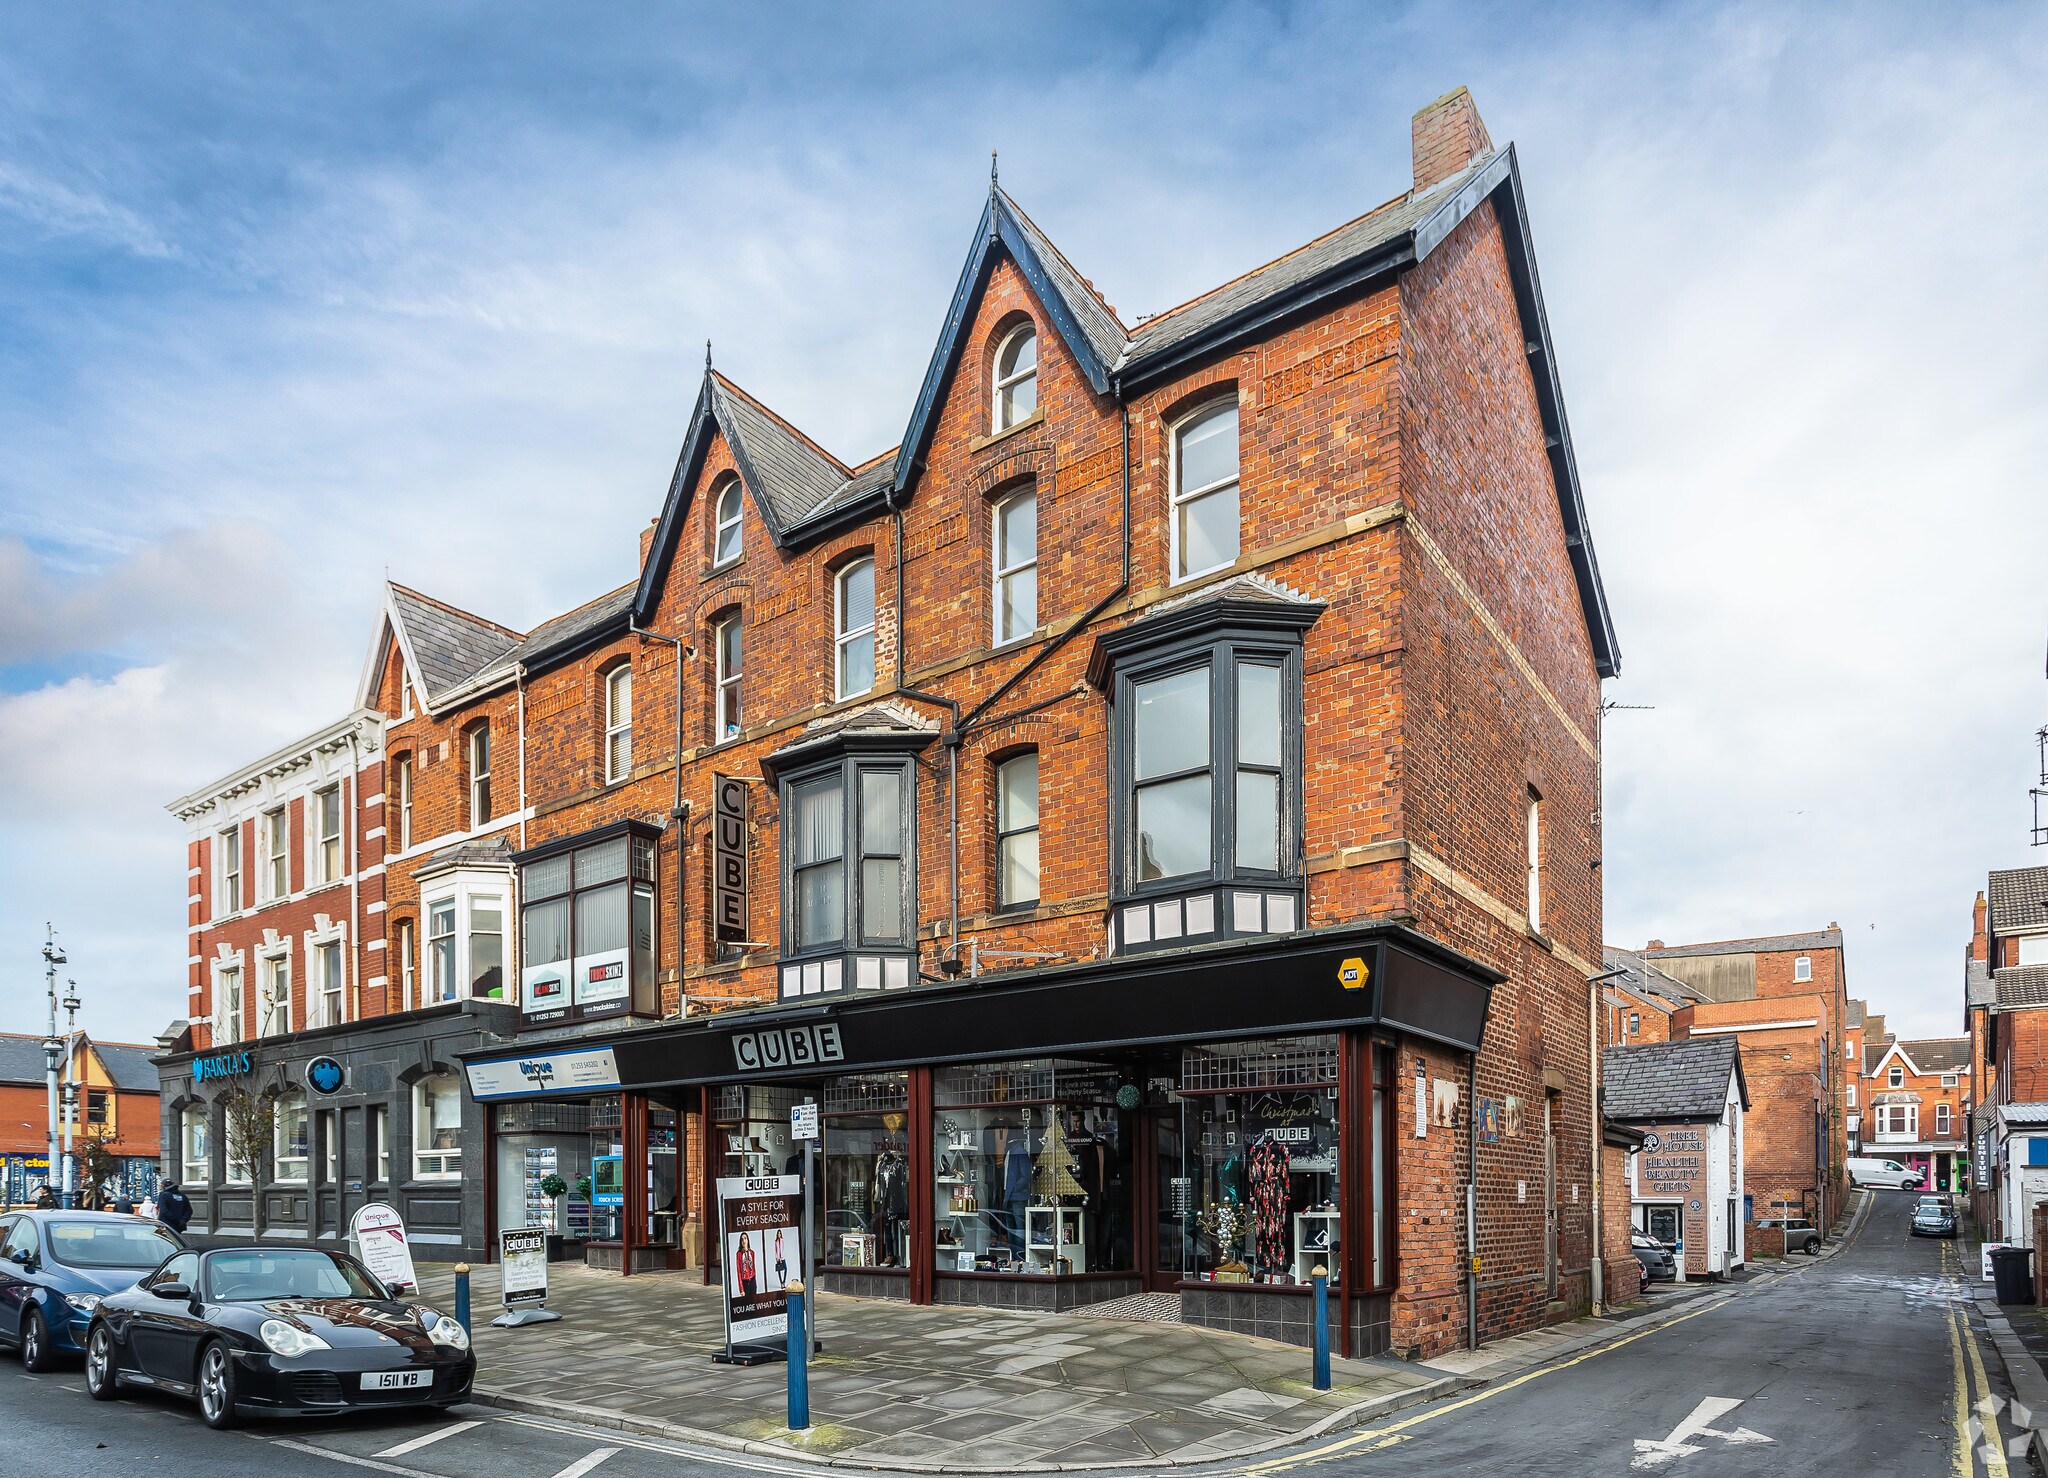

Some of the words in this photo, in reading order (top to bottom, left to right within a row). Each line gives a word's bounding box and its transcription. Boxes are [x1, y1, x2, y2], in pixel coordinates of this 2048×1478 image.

[721, 783, 742, 926] CUBE
[1344, 970, 1358, 980] ADT
[737, 1027, 838, 1067] CUBE
[519, 1060, 553, 1076] Unique
[1261, 1102, 1314, 1119] Christmas
[1666, 1131, 1698, 1141] TREE
[1661, 1140, 1705, 1153] HOUSE
[1645, 1156, 1699, 1169] HEALTH
[1978, 1135, 1987, 1181] FURNITURE
[1645, 1169, 1699, 1180] BEAUTY
[746, 1179, 778, 1190] CUBE
[1652, 1181, 1691, 1192] GIFTS
[740, 1203, 747, 1213] A
[747, 1201, 768, 1212] STYLE
[769, 1200, 784, 1211] FOR
[365, 1213, 390, 1221] Unique
[736, 1215, 758, 1226] EVERY
[760, 1213, 789, 1224] SEASON
[508, 1238, 539, 1249] CUBE
[512, 1279, 539, 1288] #ShopLocal
[732, 1306, 745, 1314] YOU
[745, 1303, 756, 1312] ARE
[756, 1300, 772, 1310] WHAT
[772, 1299, 785, 1308] YOU
[733, 1321, 757, 1333] FASHION
[757, 1316, 787, 1328] EXCELLENC
[379, 1374, 399, 1387] 1511
[403, 1373, 418, 1386] WB
